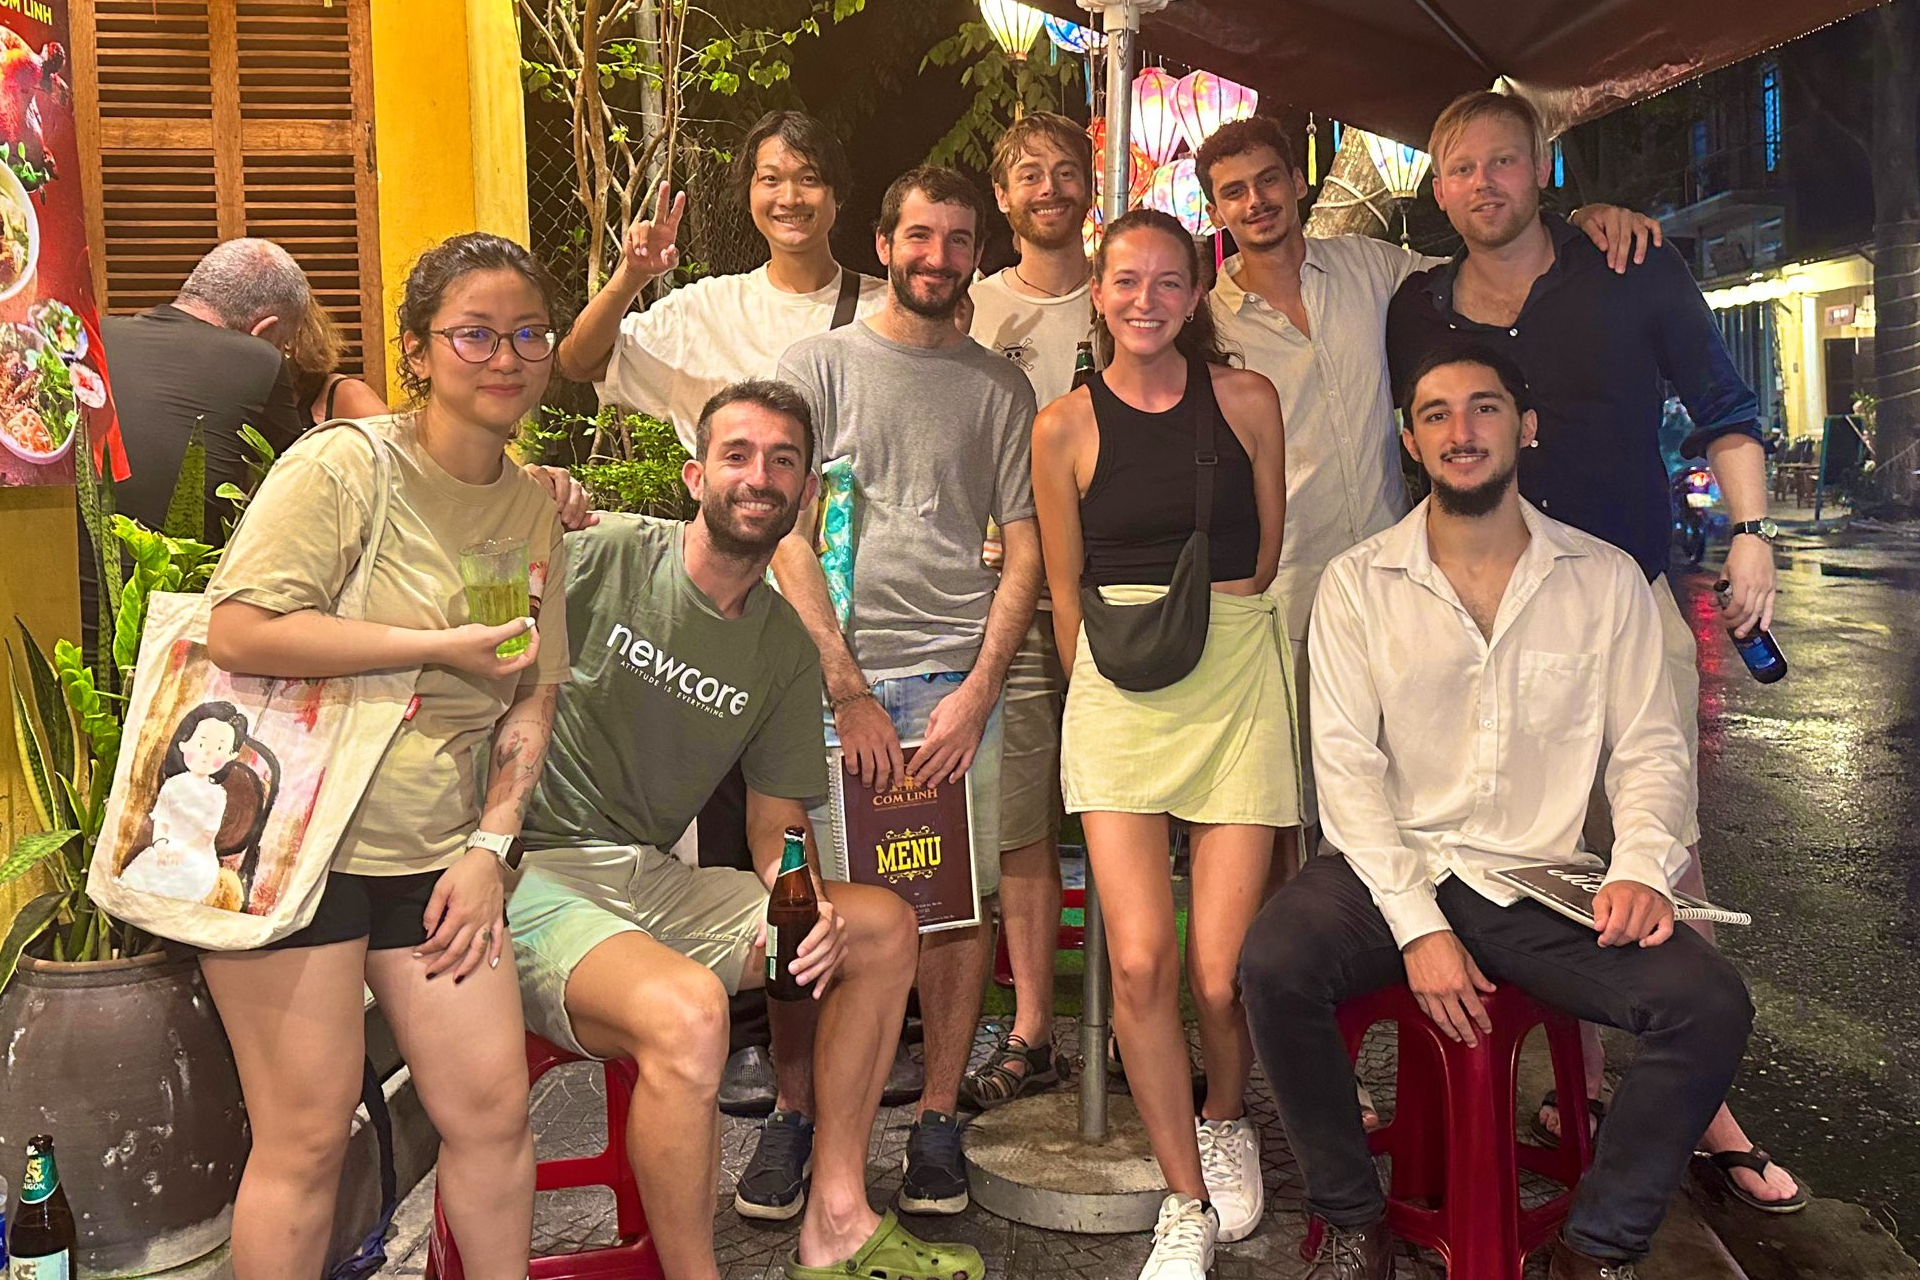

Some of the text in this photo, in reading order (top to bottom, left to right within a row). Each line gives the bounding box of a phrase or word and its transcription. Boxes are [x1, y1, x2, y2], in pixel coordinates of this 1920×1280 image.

[24, 0, 53, 26] LINH
[606, 623, 749, 716] newcore
[620, 660, 724, 718] ATTITUDE IS EVERYTHING
[907, 788, 938, 801] LINH
[875, 836, 941, 874] MENU
